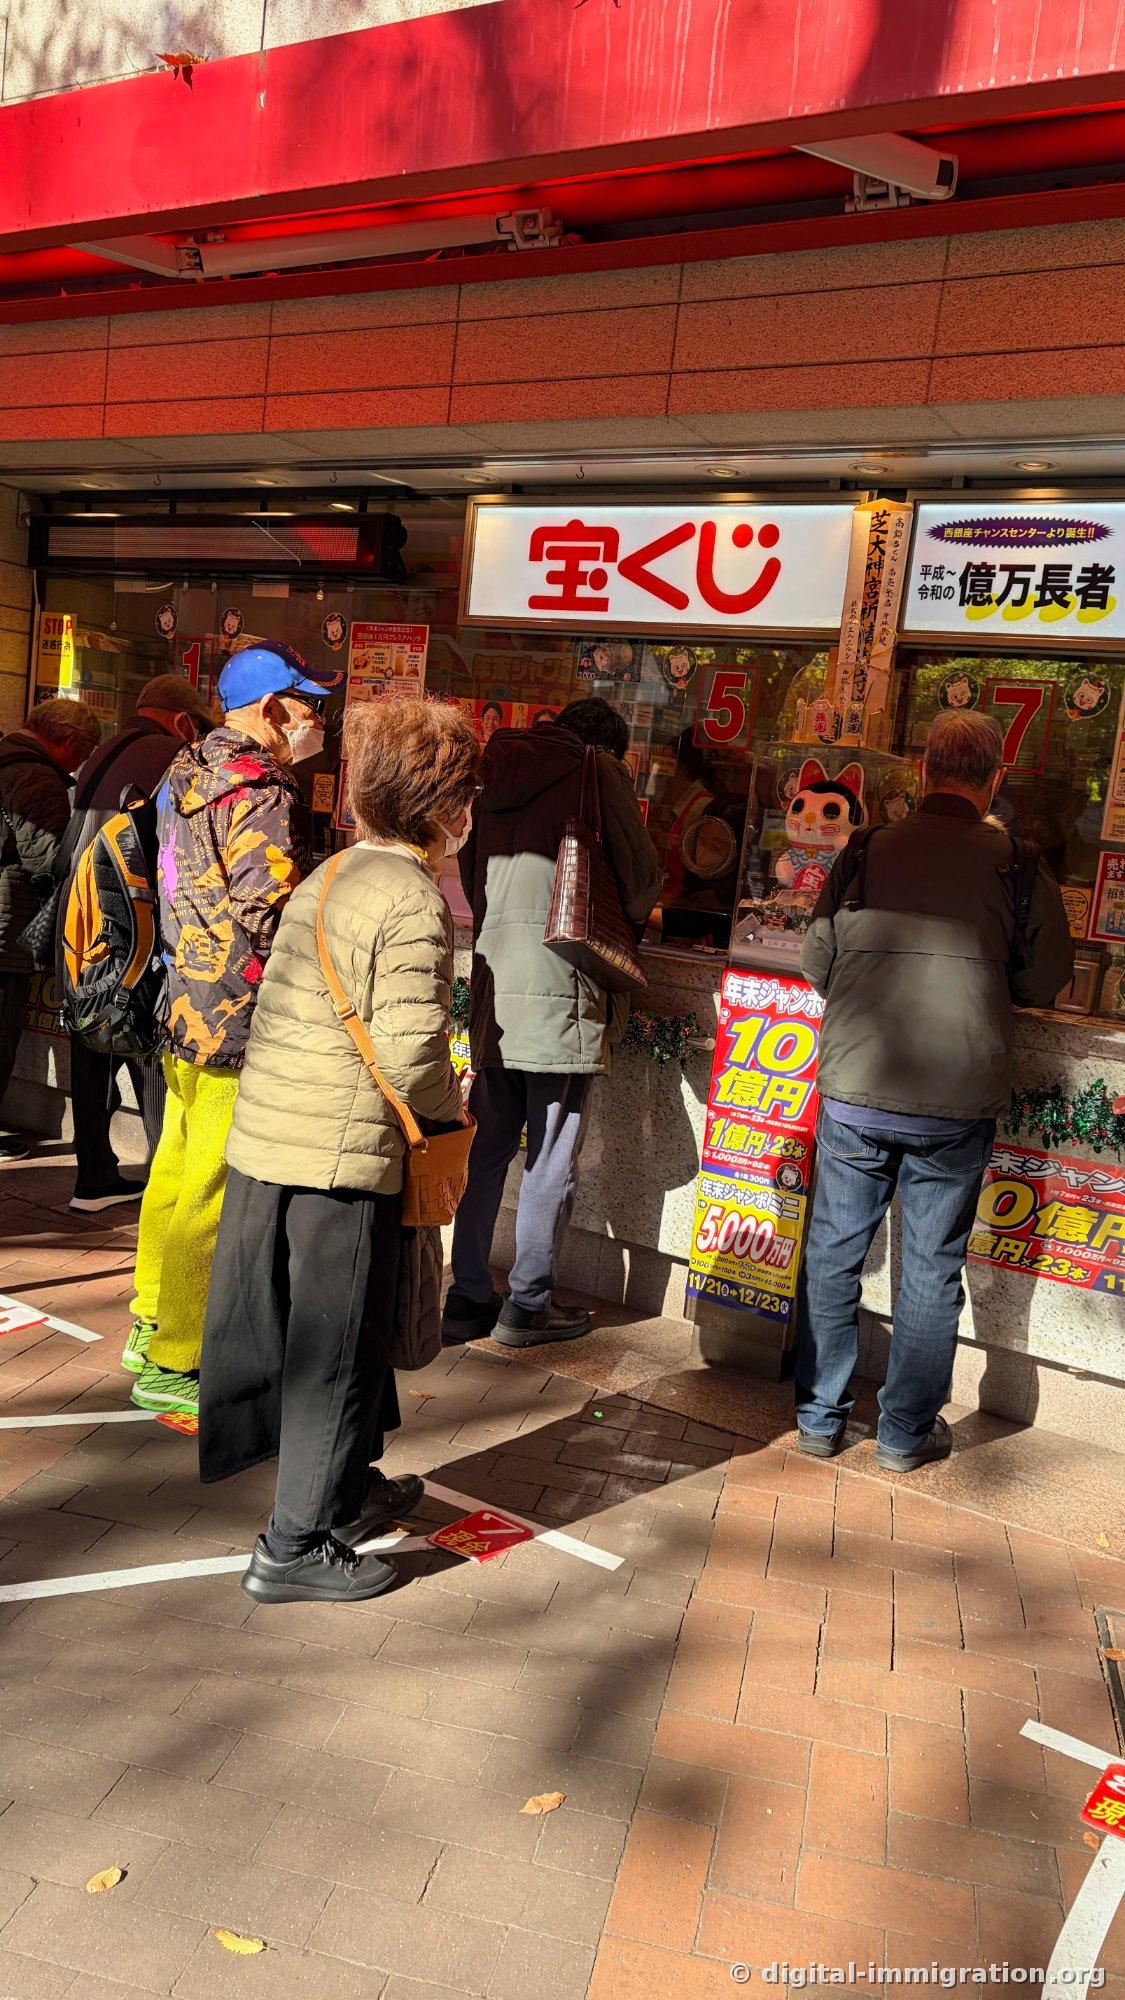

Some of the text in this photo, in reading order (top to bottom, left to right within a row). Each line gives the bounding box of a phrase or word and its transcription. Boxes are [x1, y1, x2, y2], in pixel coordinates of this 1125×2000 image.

[528, 518, 781, 614] 宝くじ
[959, 561, 1116, 610] 億万長者
[917, 585, 955, 601] 令和の
[44, 618, 73, 635] STOP
[702, 671, 748, 743] 5
[992, 686, 1044, 766] 7
[727, 1015, 817, 1073] 10
[715, 1065, 810, 1117] 億円
[700, 1177, 800, 1220] 年末ジャンボミニ
[696, 1203, 797, 1269] 5,000万円
[1087, 1797, 1125, 1831] 現
